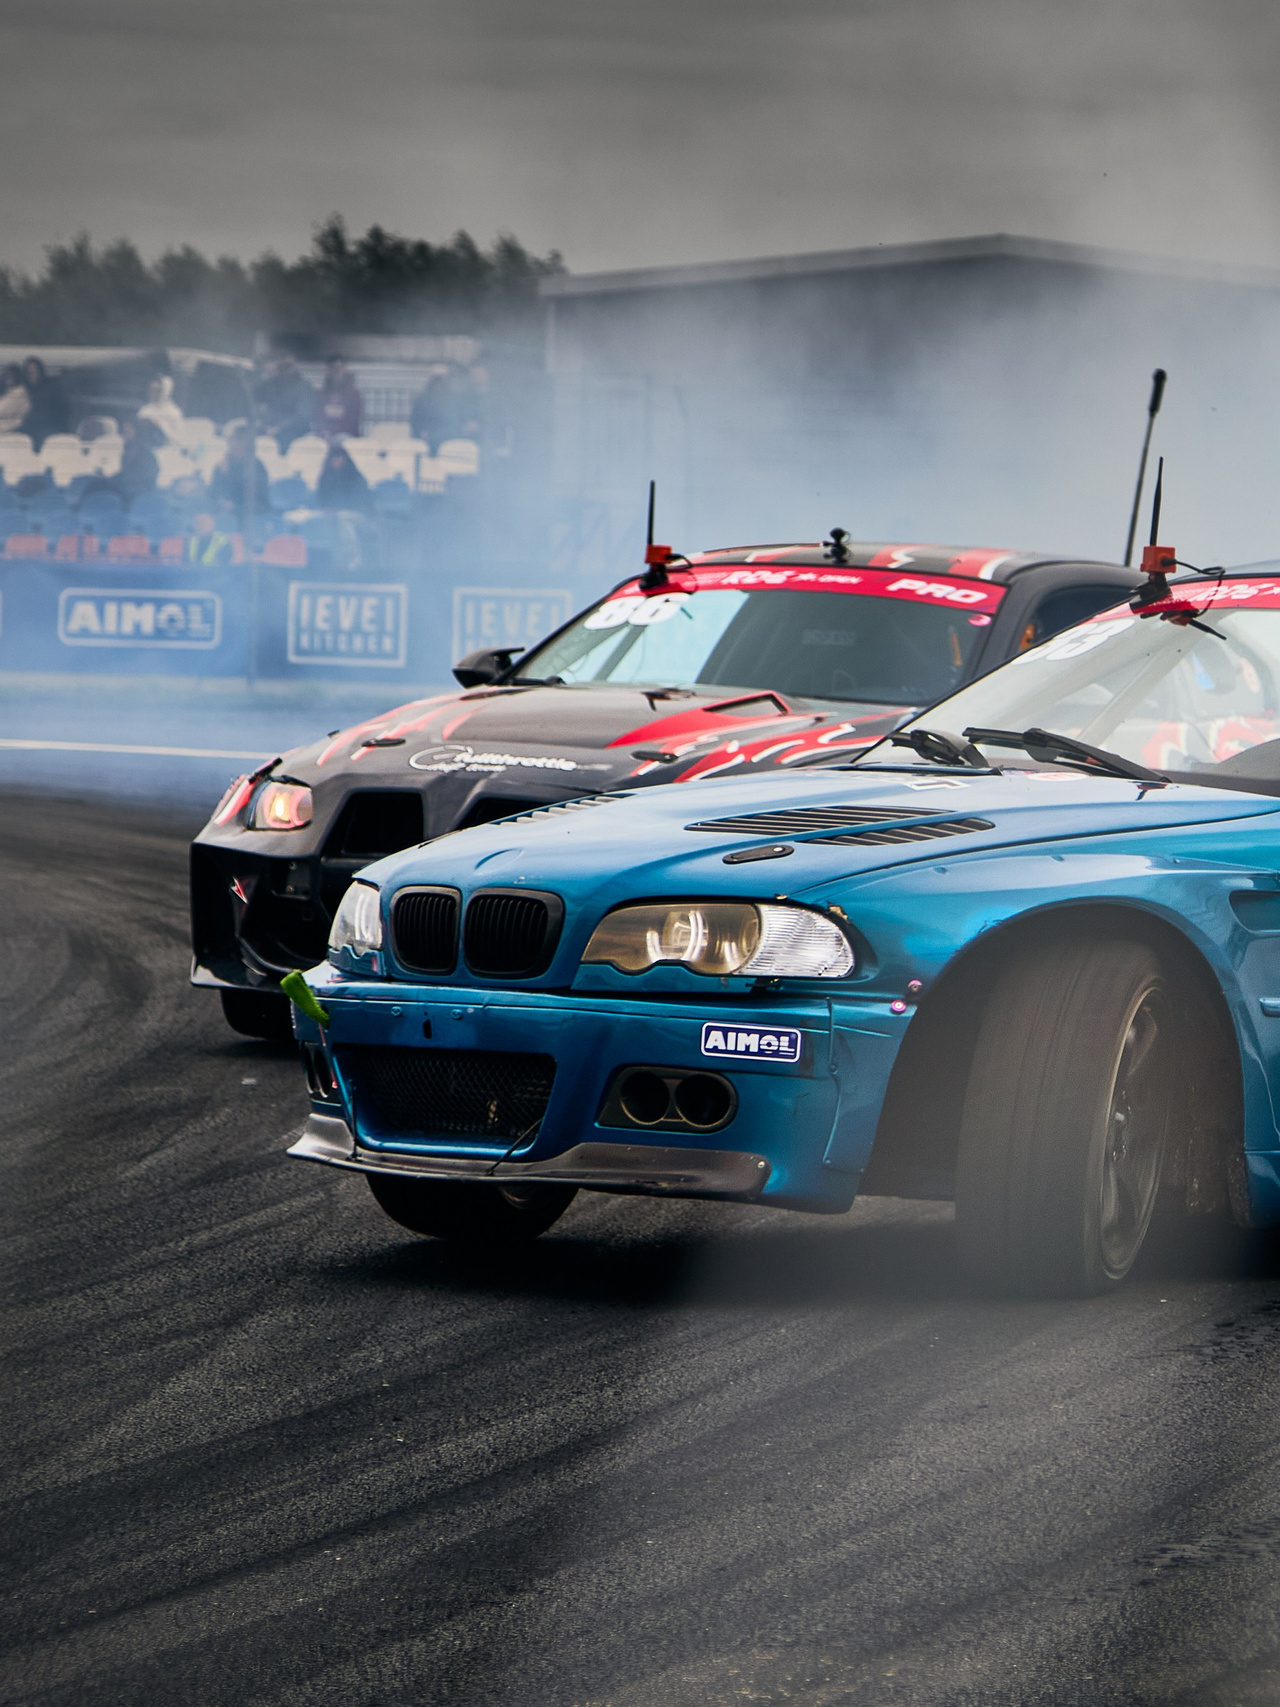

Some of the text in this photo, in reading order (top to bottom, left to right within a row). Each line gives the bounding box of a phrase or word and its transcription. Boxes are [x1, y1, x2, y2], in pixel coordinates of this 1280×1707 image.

[886, 578, 987, 603] PRO
[67, 601, 212, 637] AIMOL
[705, 1030, 795, 1055] AIMOL
